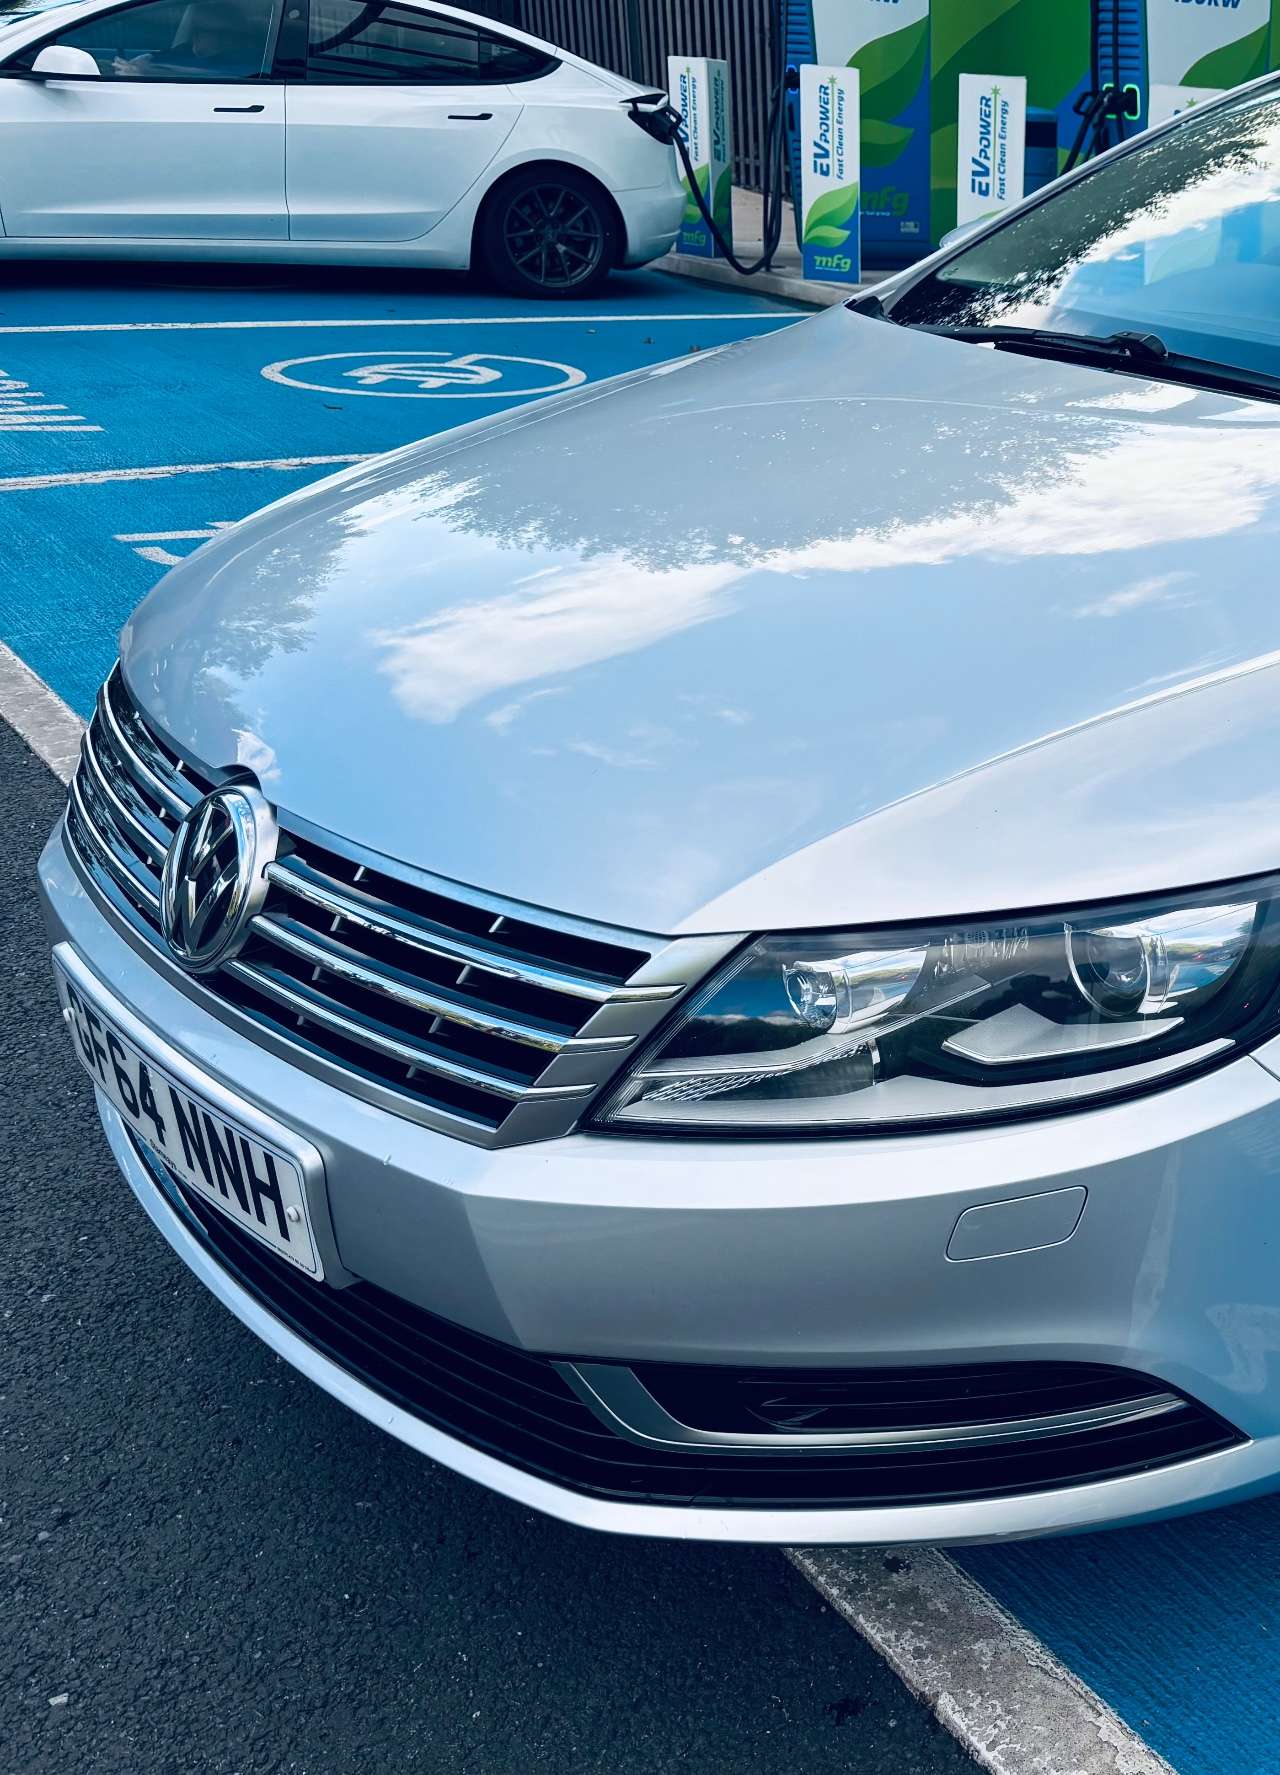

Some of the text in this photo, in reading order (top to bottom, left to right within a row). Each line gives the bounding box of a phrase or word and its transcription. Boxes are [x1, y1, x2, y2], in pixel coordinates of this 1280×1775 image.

[836, 88, 845, 125] Energy
[836, 127, 844, 157] Clean
[997, 100, 1010, 200] Fast Clean Energy
[66, 982, 291, 1243] GF64 NNH
